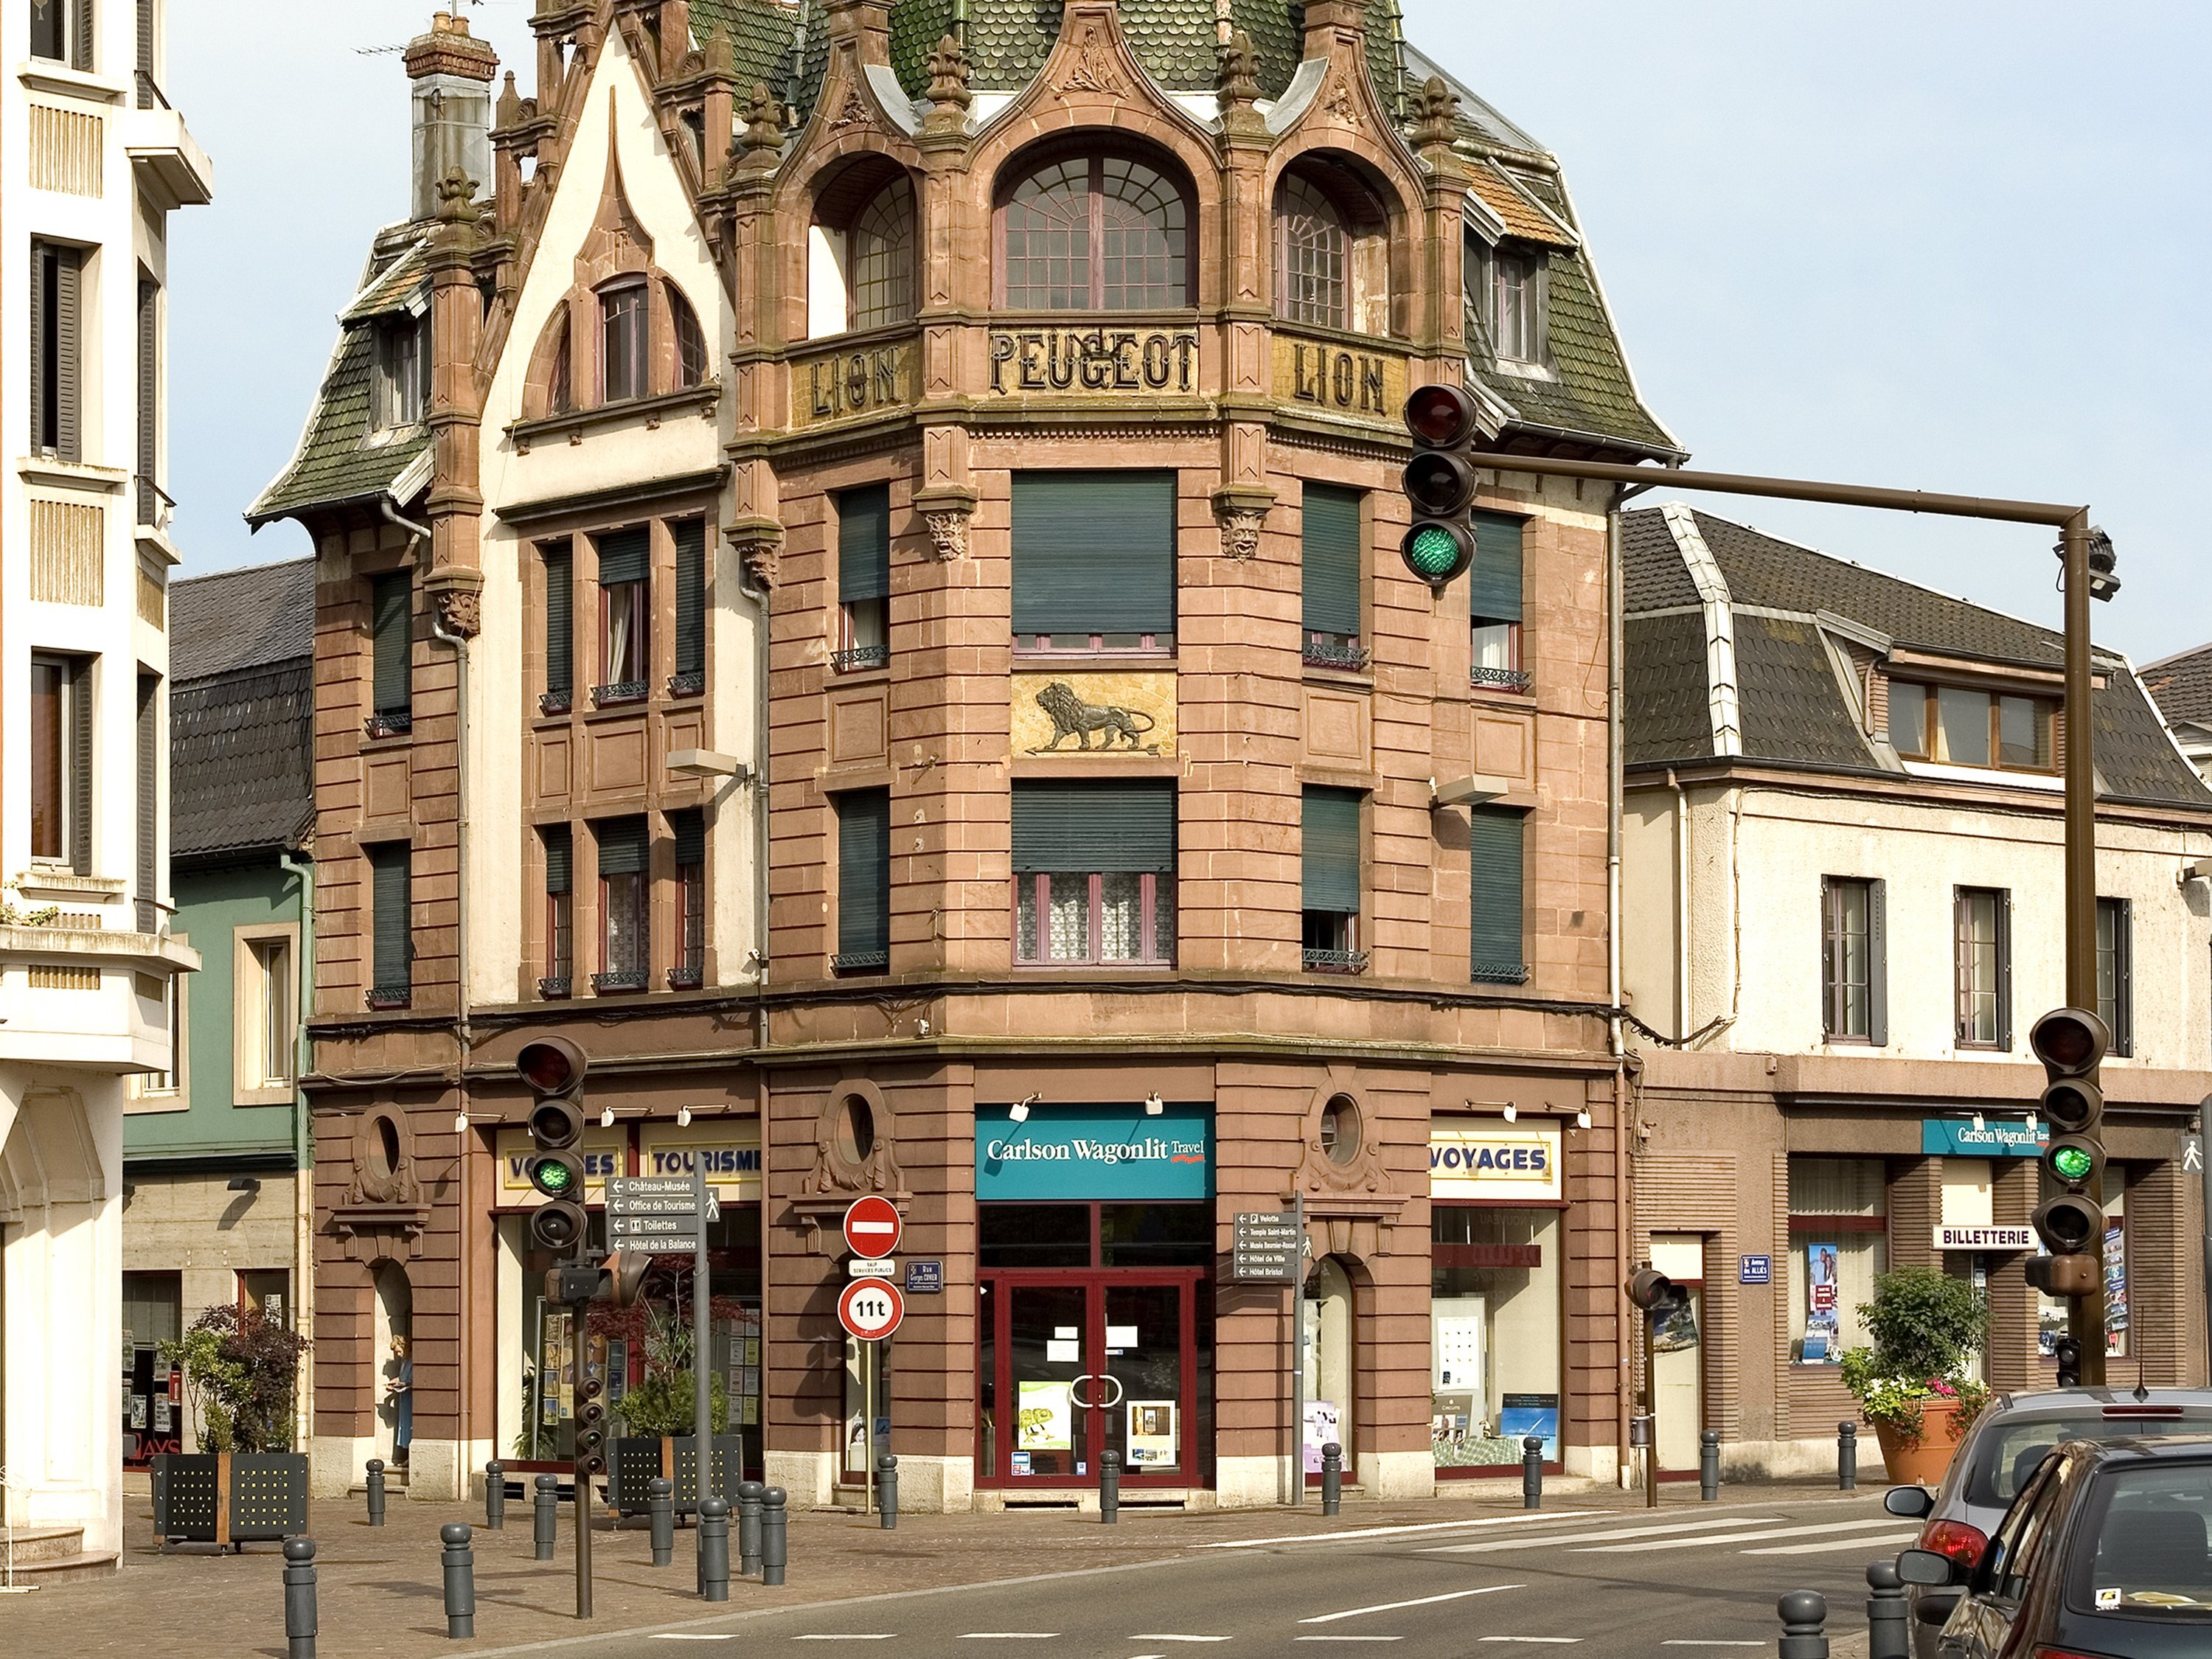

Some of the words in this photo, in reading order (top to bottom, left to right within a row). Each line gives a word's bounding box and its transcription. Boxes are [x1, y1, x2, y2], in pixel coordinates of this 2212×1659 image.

[990, 330, 1200, 394] PEUGEOT
[811, 345, 901, 414] LION
[1293, 344, 1386, 417] LION
[1958, 1127, 1994, 1143] Carlson
[1994, 1127, 2036, 1147] Wagonlit
[2037, 1130, 2050, 1140] Trave
[987, 1138, 1071, 1161] Carlson
[1071, 1137, 1169, 1164] Wagonlit
[1171, 1140, 1204, 1154] Travel
[1430, 1147, 1545, 1169] VOYAGES
[629, 1180, 690, 1192] Château-Musée
[629, 1200, 651, 1210] Office
[653, 1200, 661, 1210] de
[664, 1200, 695, 1210] Tourisme
[644, 1220, 677, 1231] Toilettes
[630, 1239, 648, 1250] Hôtel
[650, 1239, 658, 1249] de
[660, 1239, 667, 1249] la
[668, 1239, 696, 1249] Balance
[1944, 1231, 2029, 1244] BILLETTERIE
[856, 1301, 886, 1317] 11t
